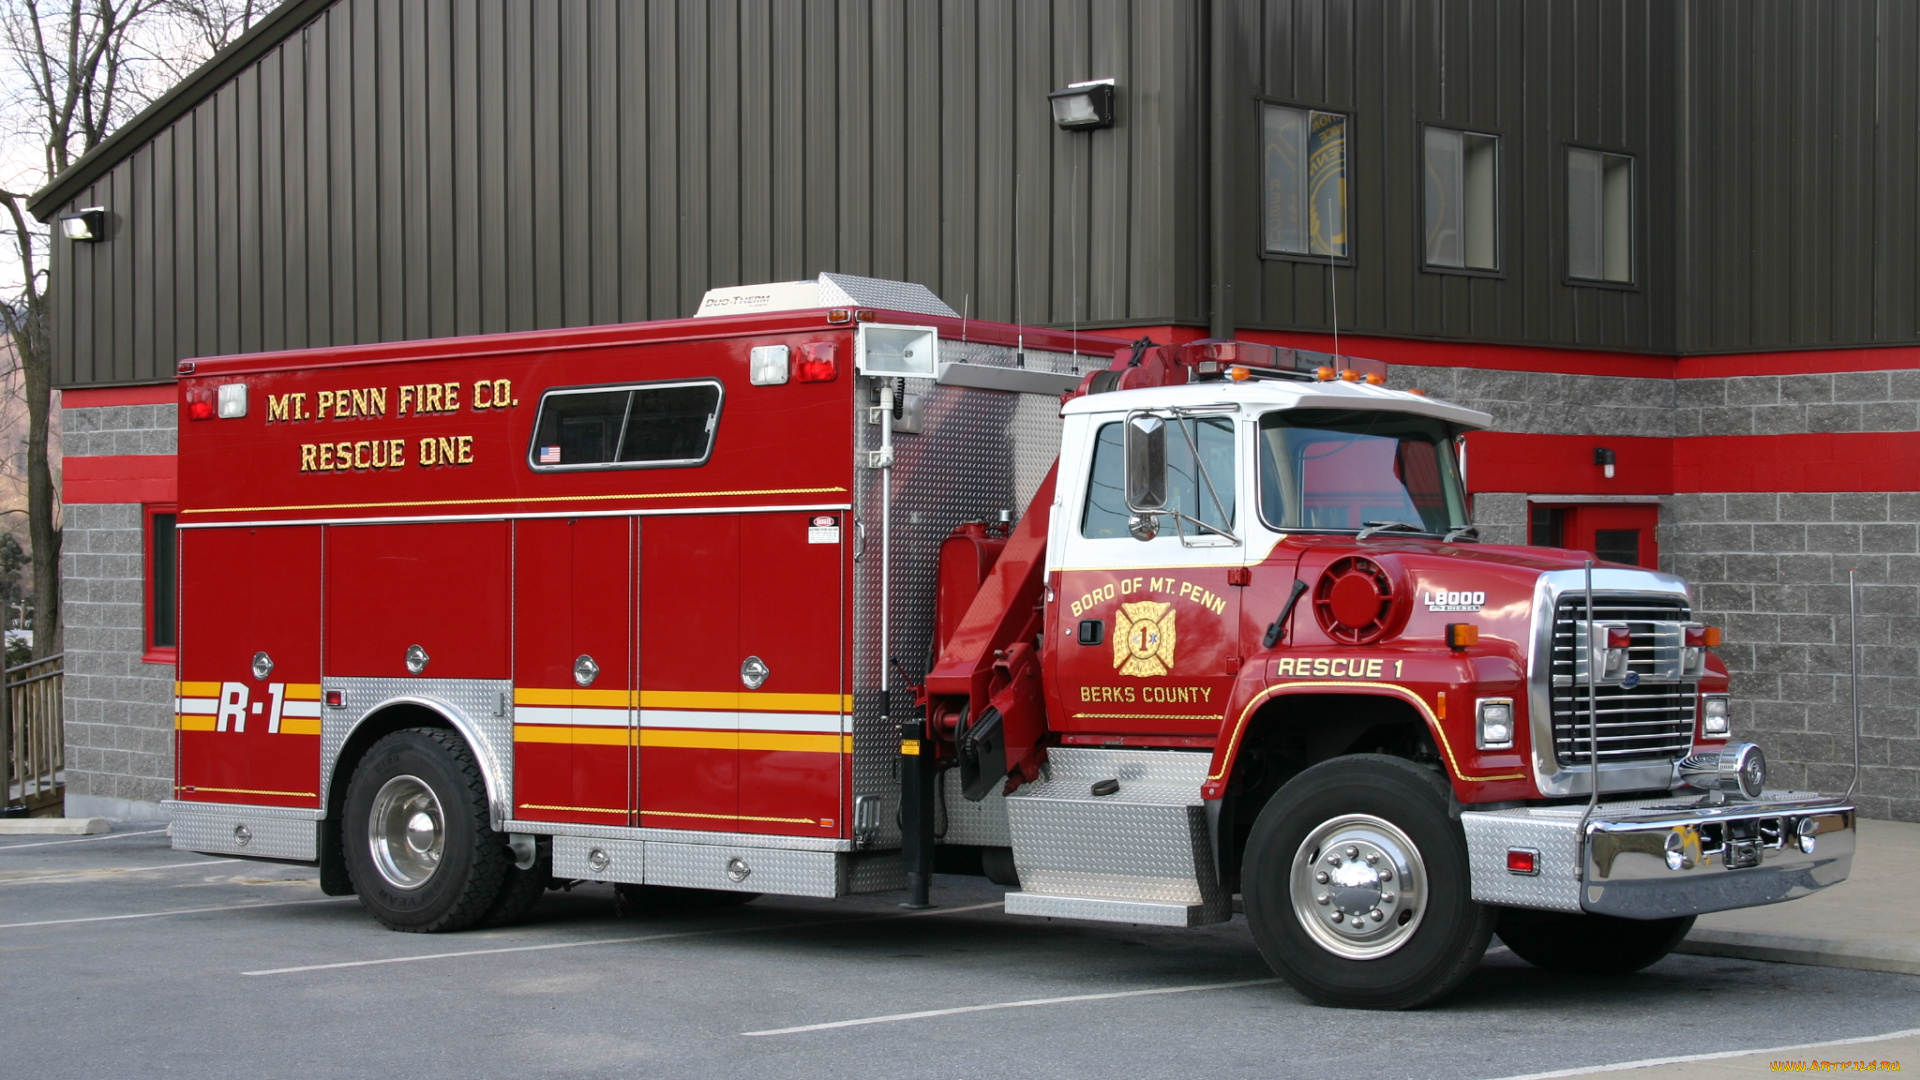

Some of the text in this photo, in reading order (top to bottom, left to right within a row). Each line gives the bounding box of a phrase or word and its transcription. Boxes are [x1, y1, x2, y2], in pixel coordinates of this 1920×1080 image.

[267, 378, 519, 422] MT. PENN FIRE CO.
[300, 435, 475, 471] RESCUE ONE
[1070, 577, 1227, 617] BORO OF MT. PENN
[1424, 591, 1486, 606] L8000
[1139, 626, 1148, 652] 1
[1277, 657, 1403, 679] RESCUE 1
[217, 681, 285, 734] R-1
[1080, 686, 1212, 703] BERKS COUNTY
